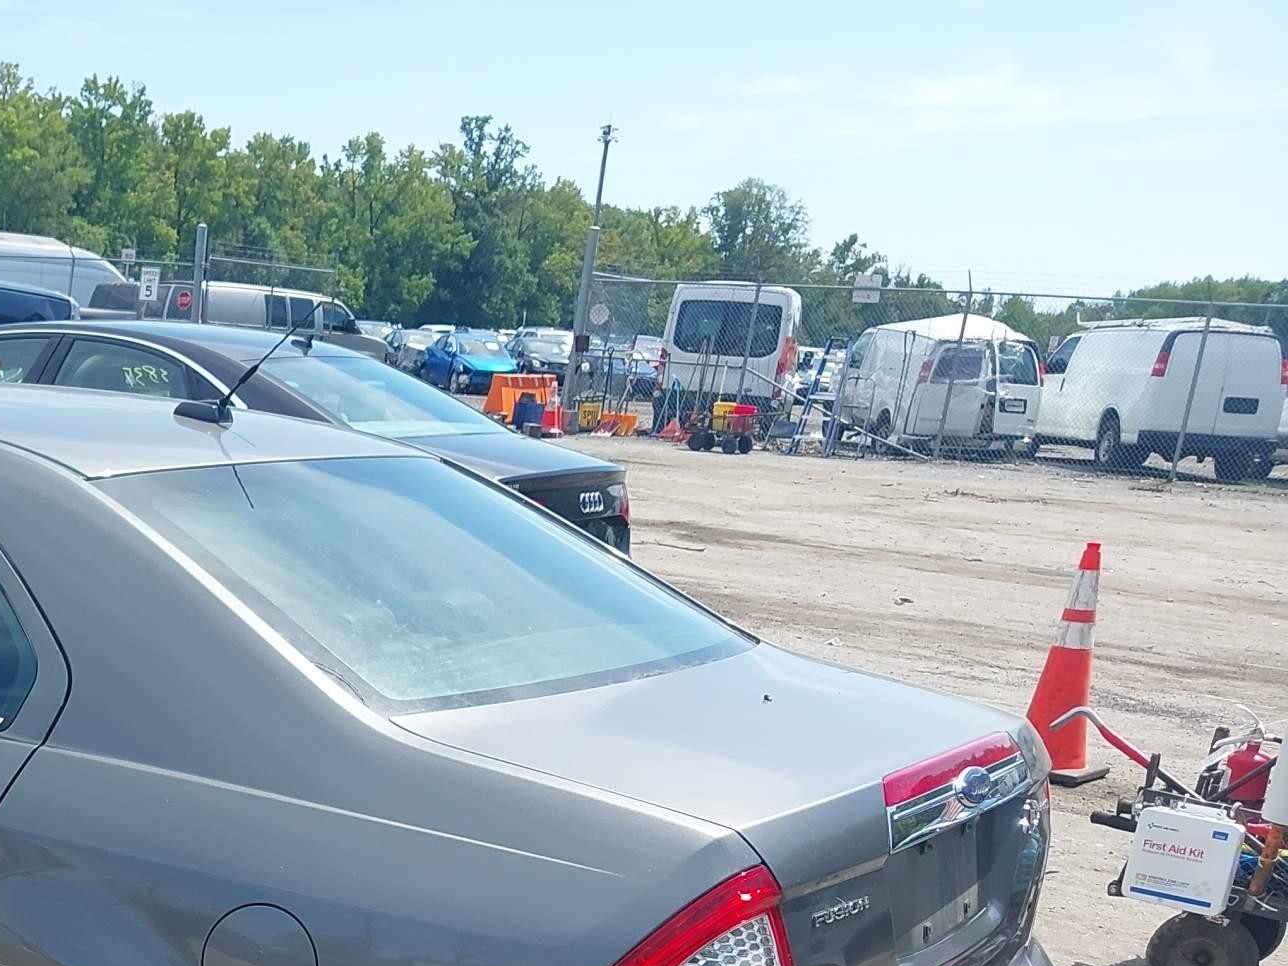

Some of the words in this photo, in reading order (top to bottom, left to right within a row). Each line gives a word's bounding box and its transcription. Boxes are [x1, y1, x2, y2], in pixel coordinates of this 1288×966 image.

[144, 285, 153, 297] 5
[1143, 839, 1167, 852] First
[1168, 844, 1187, 855] Aid
[1189, 847, 1204, 859] Kit
[812, 896, 871, 928] FUSION
